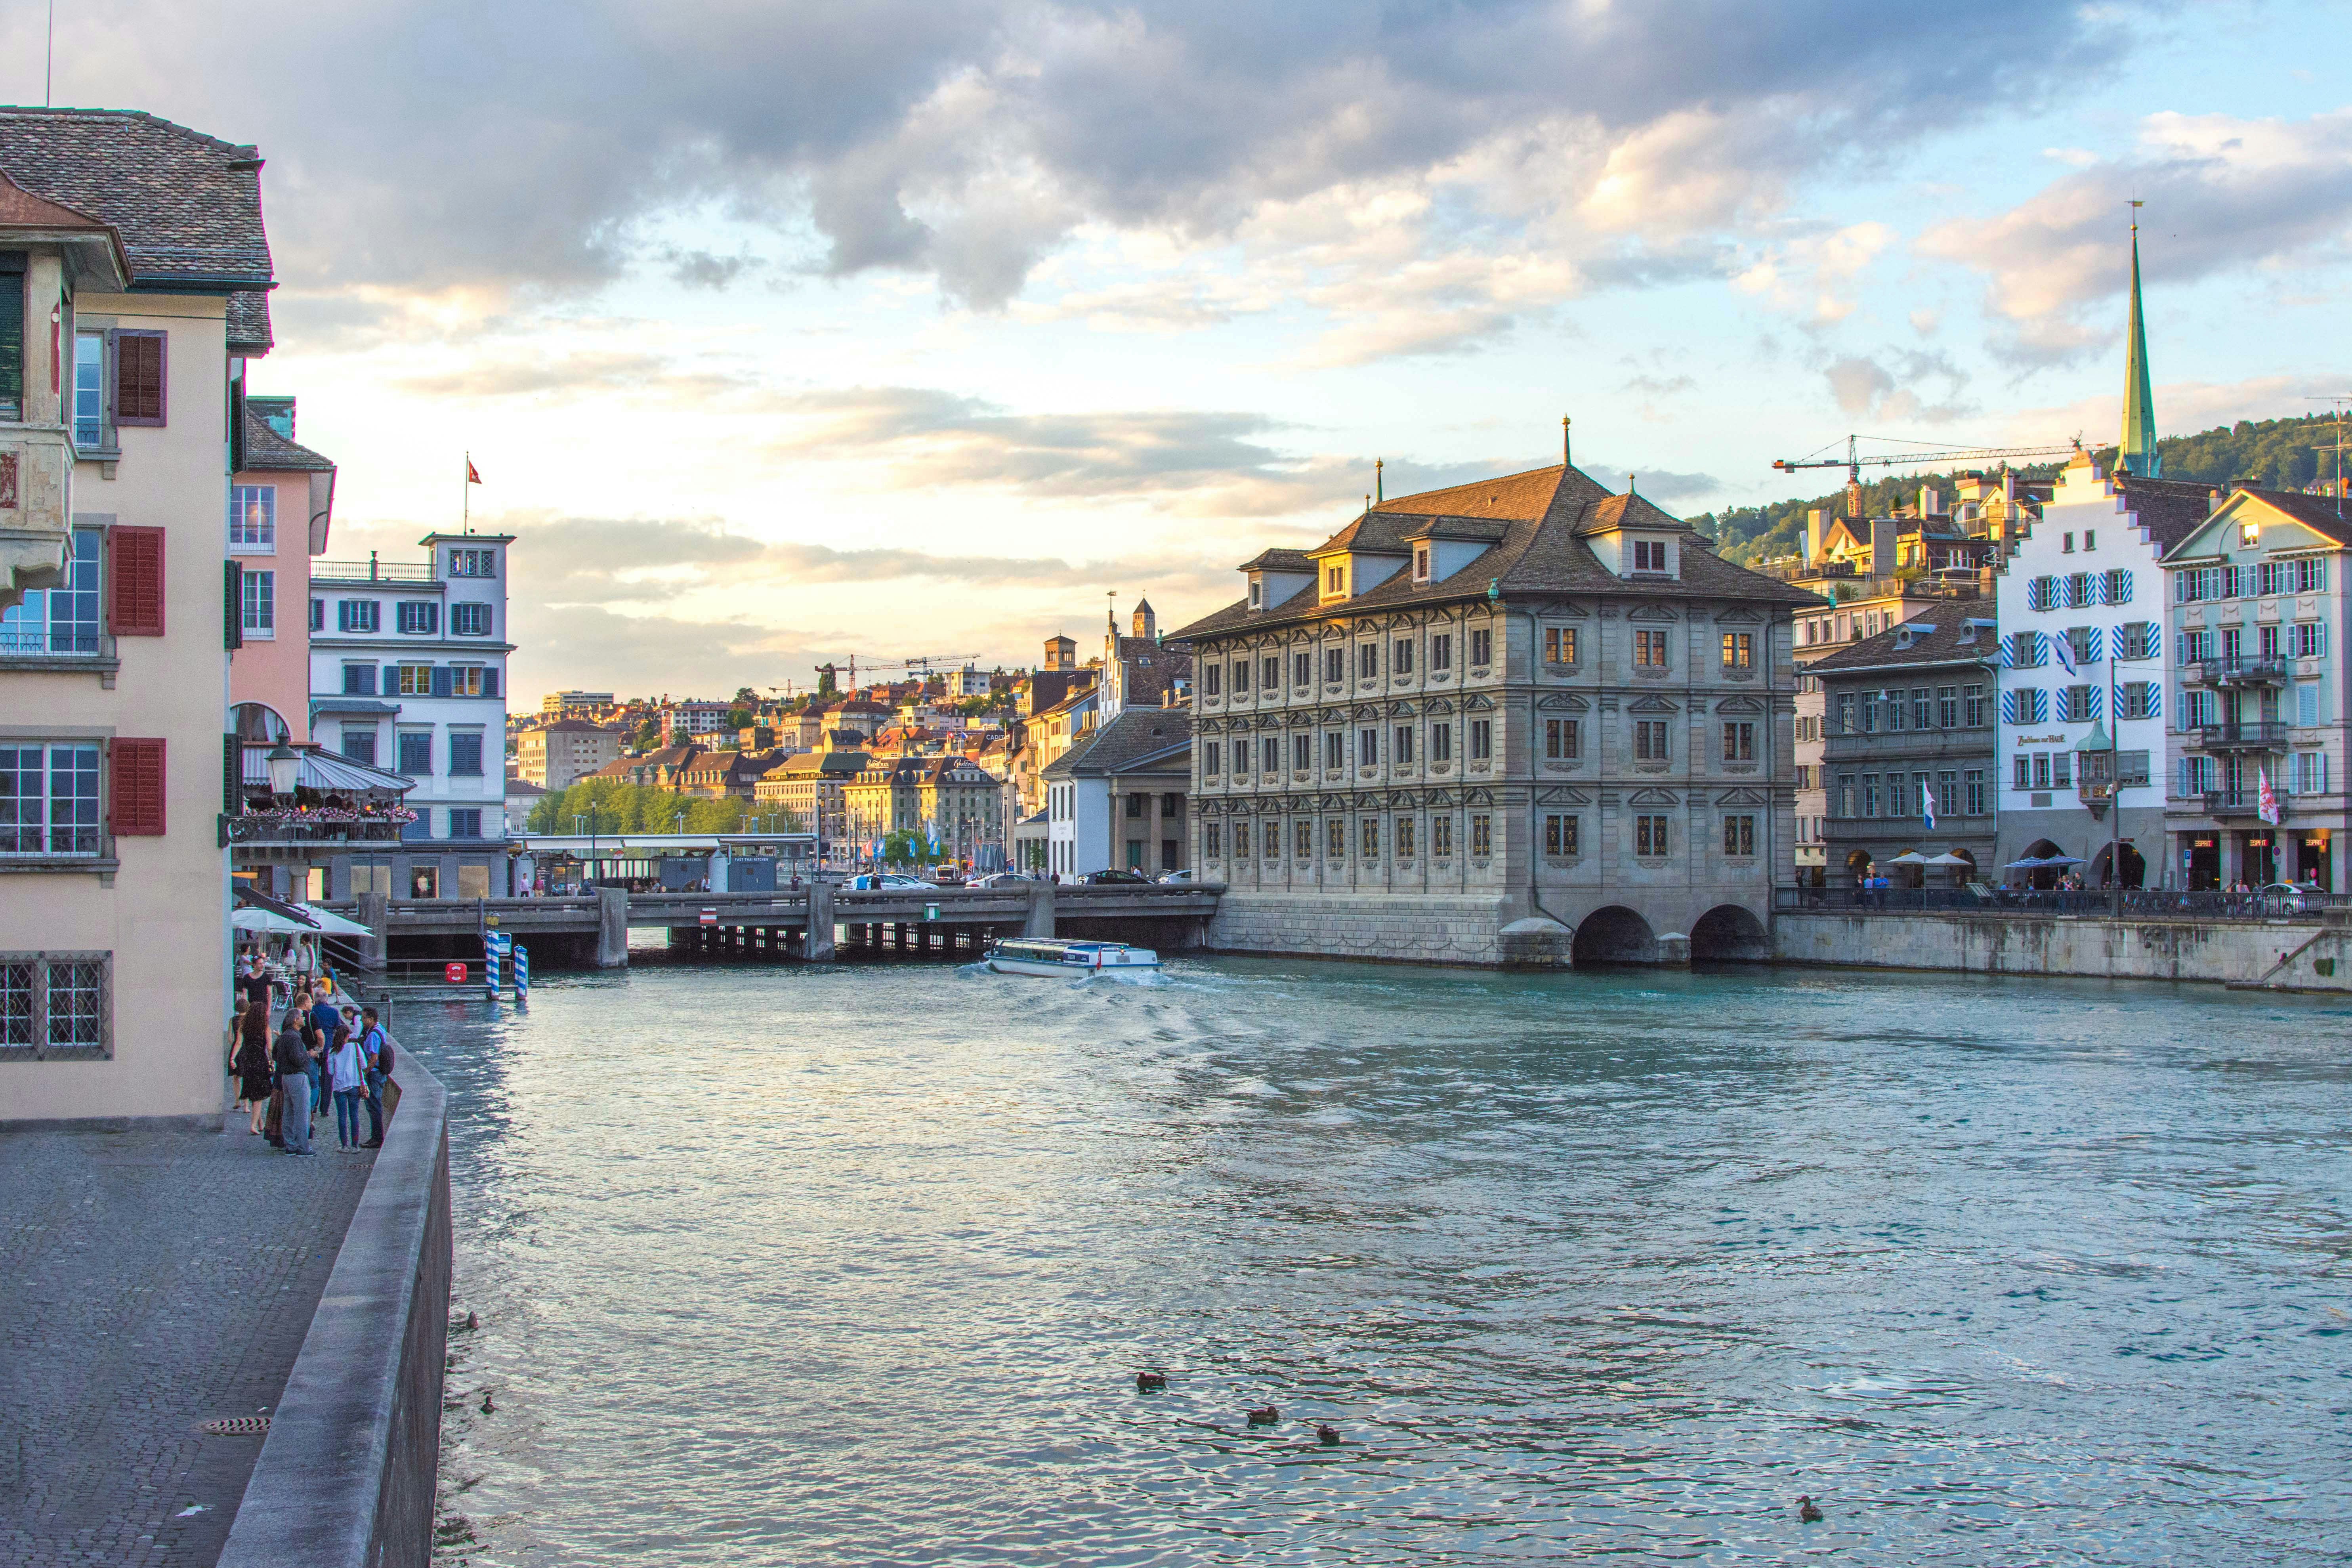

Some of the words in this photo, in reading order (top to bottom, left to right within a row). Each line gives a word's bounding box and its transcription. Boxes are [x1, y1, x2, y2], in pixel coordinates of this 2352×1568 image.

[2017, 735, 2040, 746] Zunfthaus
[867, 759, 881, 768] Central
[954, 758, 979, 768] Central
